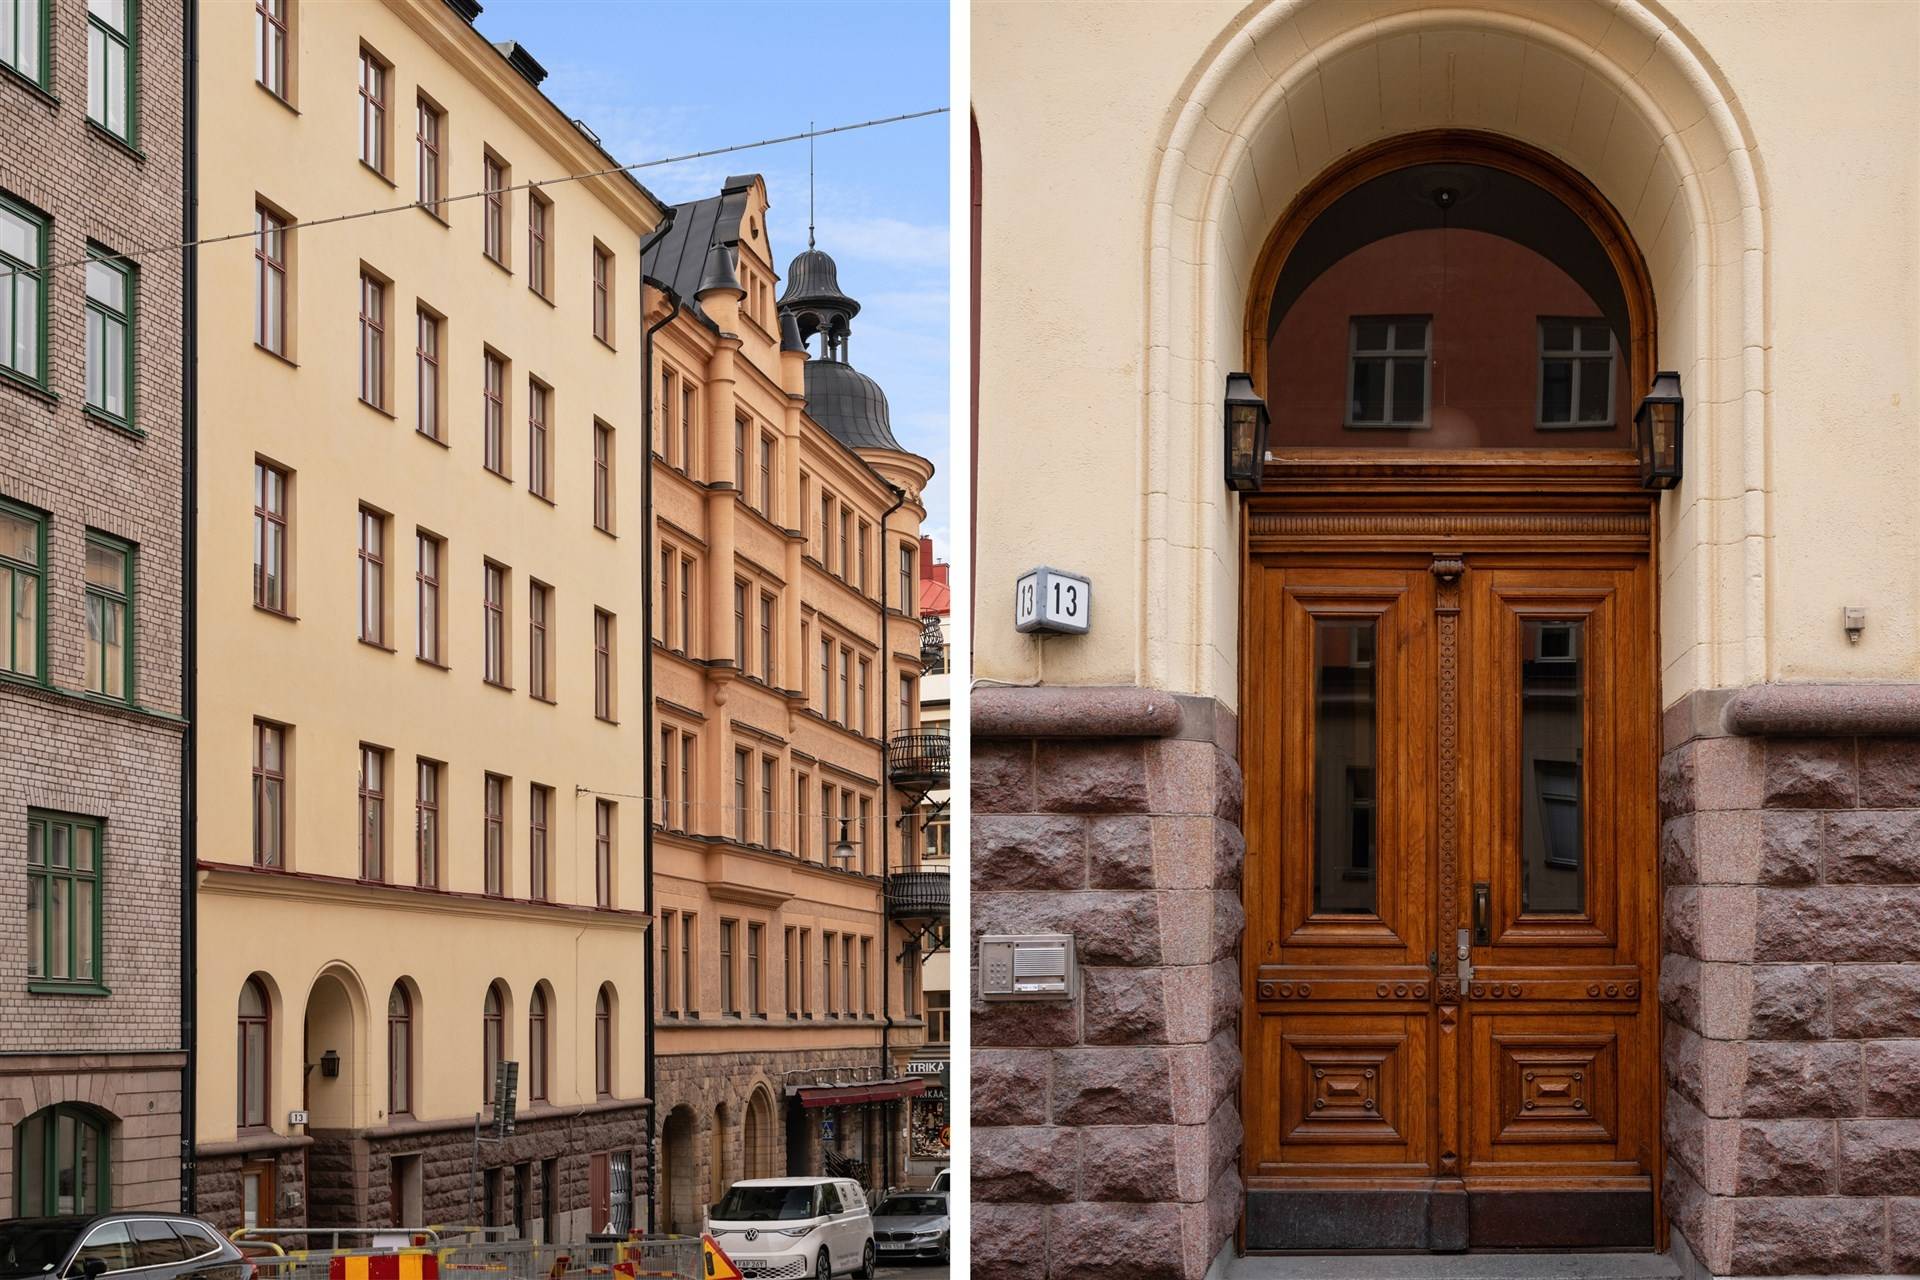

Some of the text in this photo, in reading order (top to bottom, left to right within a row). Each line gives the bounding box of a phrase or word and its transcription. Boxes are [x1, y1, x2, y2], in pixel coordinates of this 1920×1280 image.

[1022, 584, 1033, 617] 13
[1054, 582, 1077, 616] 13
[294, 1113, 303, 1122] 13
